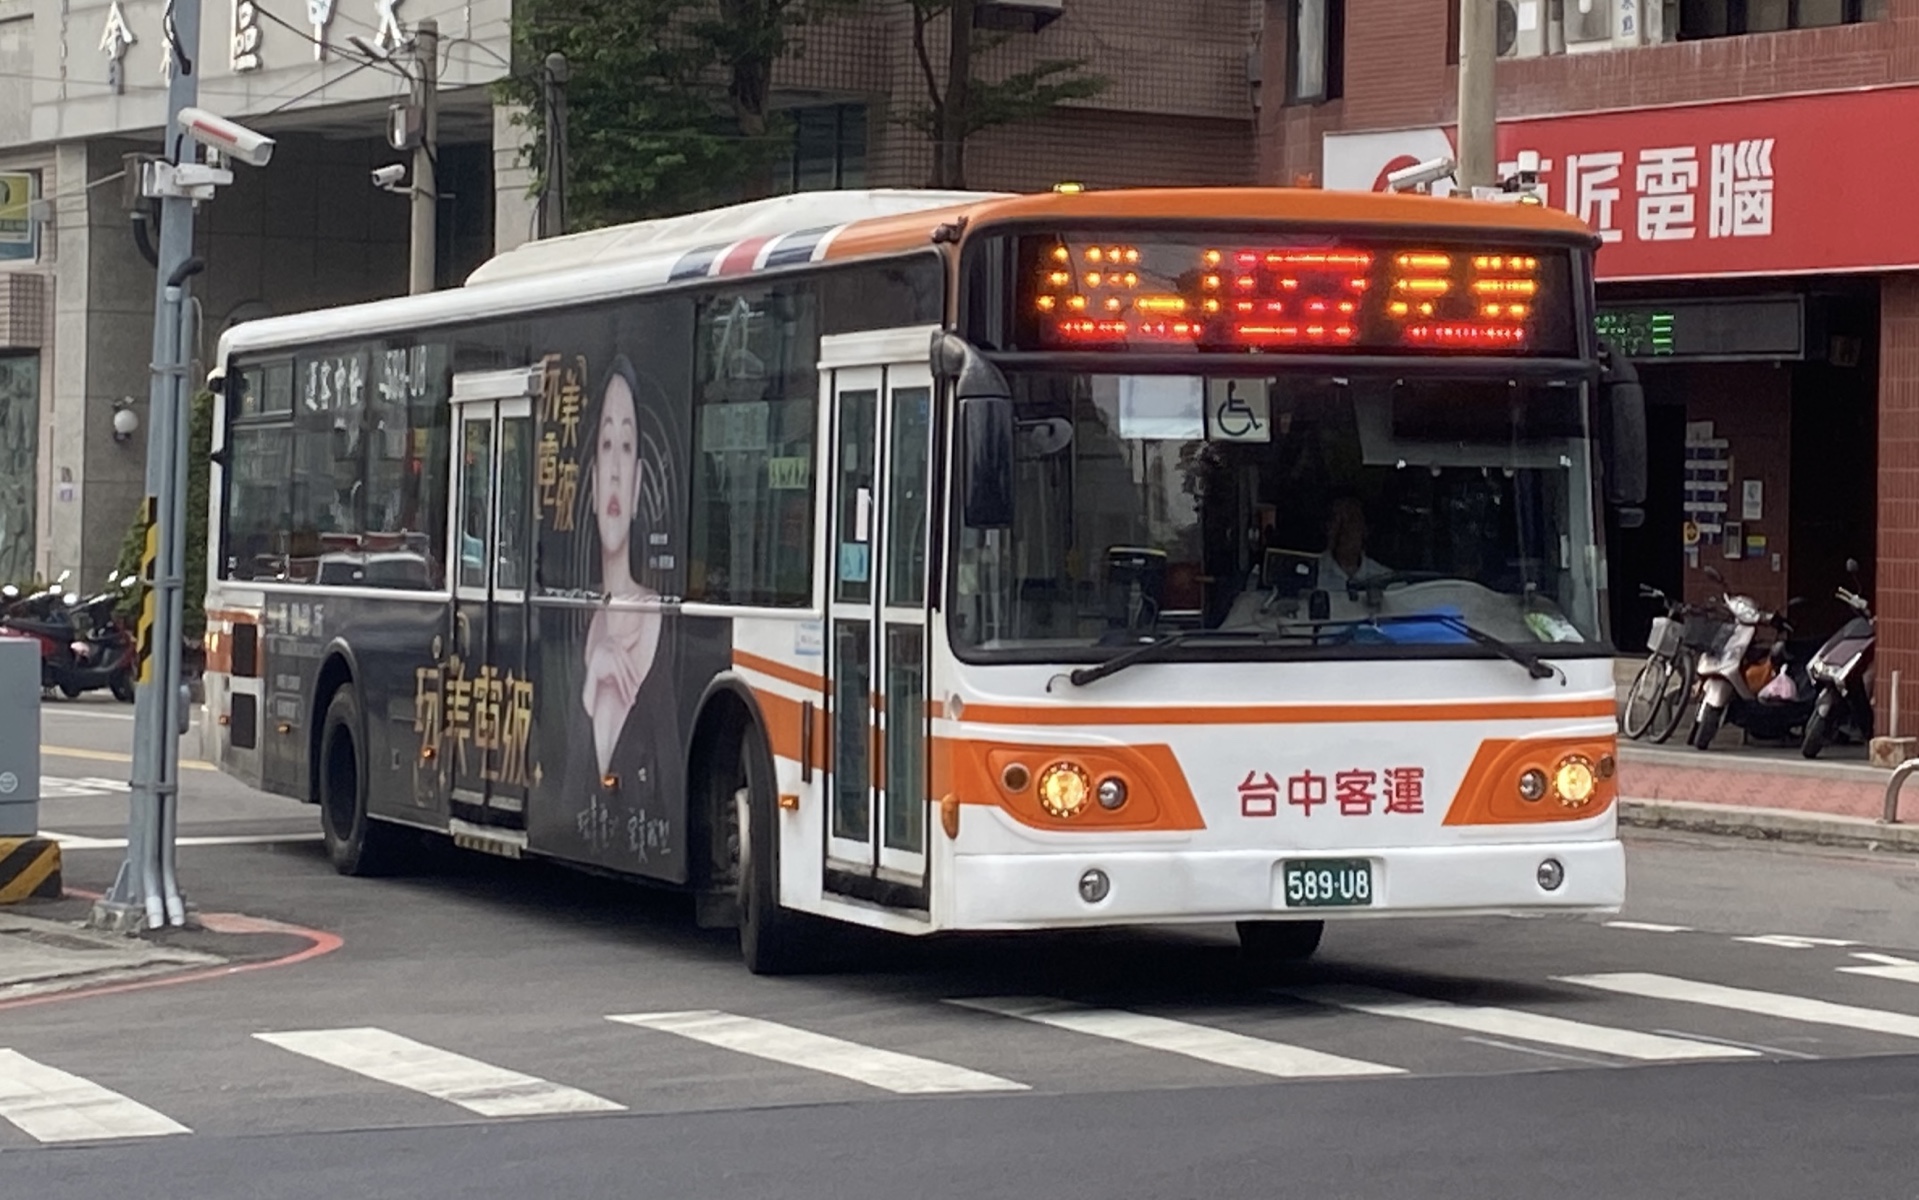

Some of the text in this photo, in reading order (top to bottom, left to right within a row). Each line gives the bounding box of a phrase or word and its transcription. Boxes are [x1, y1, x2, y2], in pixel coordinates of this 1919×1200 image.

[414, 660, 534, 787] 玩美電波
[1237, 766, 1426, 818] 台中客運
[1287, 869, 1370, 900] 589-U8
